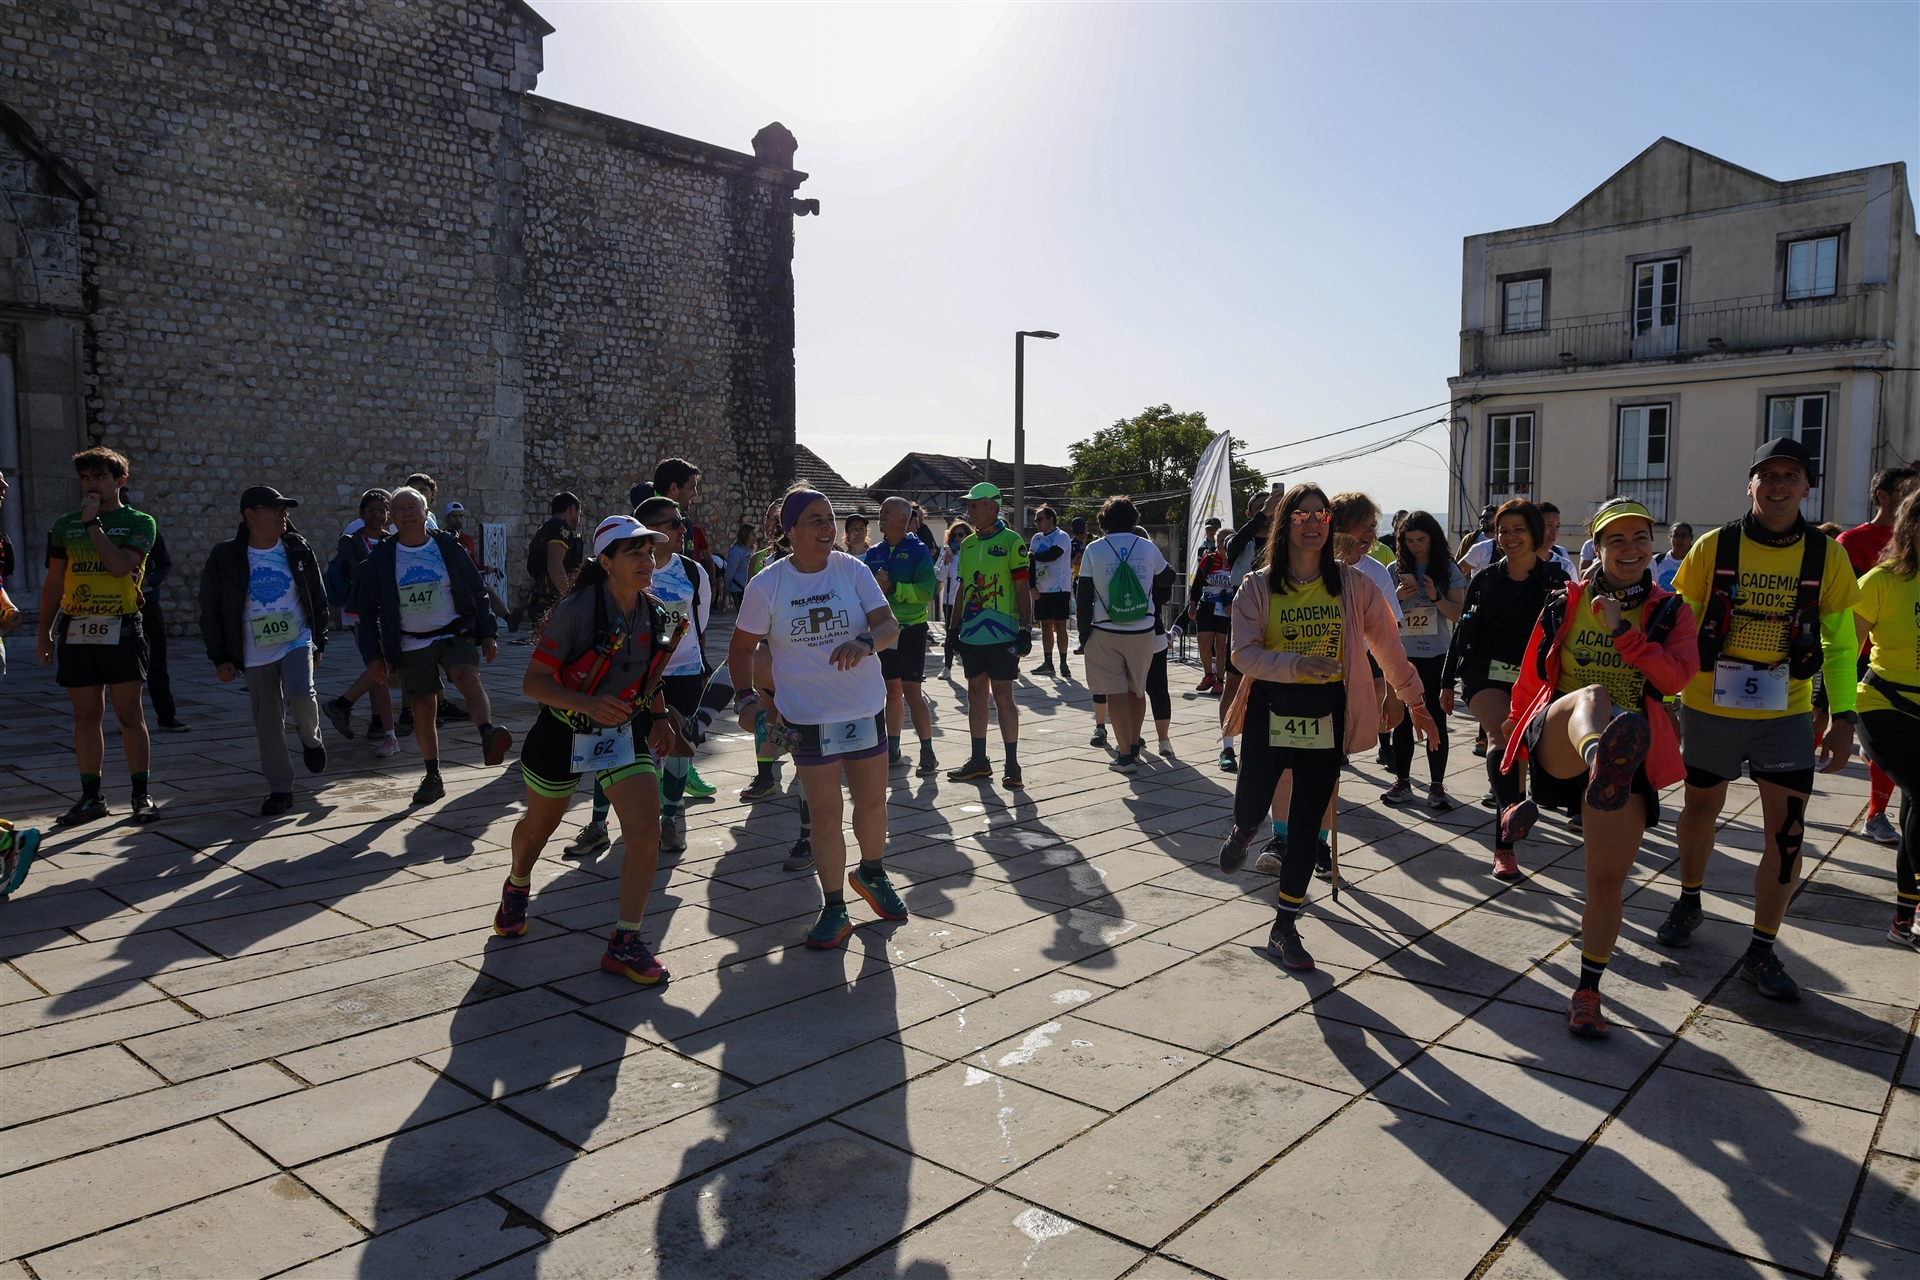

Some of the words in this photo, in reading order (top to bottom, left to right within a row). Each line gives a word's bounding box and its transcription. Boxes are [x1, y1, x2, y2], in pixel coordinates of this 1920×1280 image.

[72, 561, 108, 573] CRUZAD
[1105, 563, 1147, 576] SARÉM
[409, 590, 433, 604] 447
[1624, 585, 1644, 596] 100%
[1751, 591, 1786, 608] 100%
[66, 604, 124, 616] CHAMUSCA
[665, 610, 680, 625] 69
[1280, 605, 1342, 624] ACADEMIA
[262, 620, 289, 635] 409
[1405, 615, 1428, 627] 122
[79, 623, 109, 635] 186
[790, 630, 849, 643] IMOBILIÁRIA
[1300, 623, 1331, 638] 100%
[1325, 622, 1342, 658] POWER
[1575, 629, 1614, 648] ACAD
[1744, 677, 1759, 695] 5
[845, 723, 857, 739] 2
[1284, 718, 1319, 735] 411
[593, 739, 615, 756] 62
